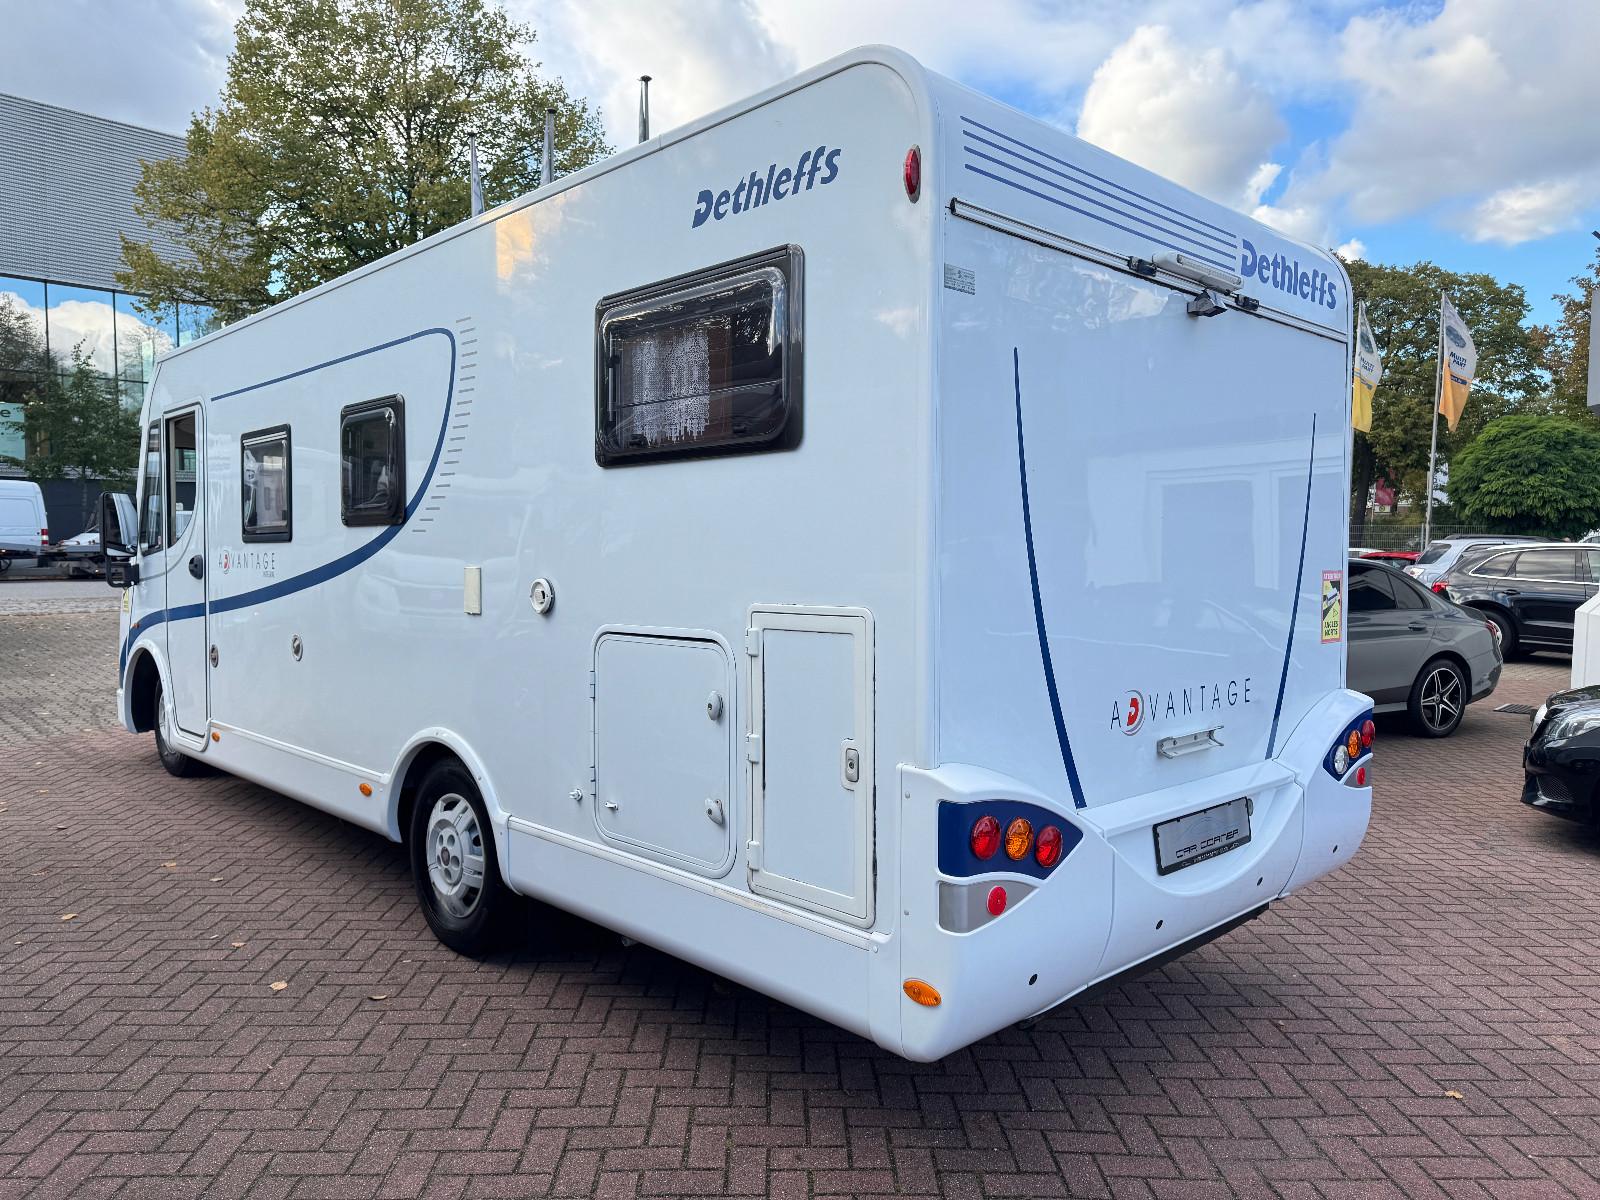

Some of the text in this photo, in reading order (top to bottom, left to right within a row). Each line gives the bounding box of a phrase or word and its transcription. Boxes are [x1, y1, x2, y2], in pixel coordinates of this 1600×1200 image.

[691, 145, 842, 229] Dethleffs
[1240, 238, 1337, 310] Dethleffs
[218, 550, 275, 574] ADVANTAGE
[1110, 678, 1251, 736] ADVANTAGE
